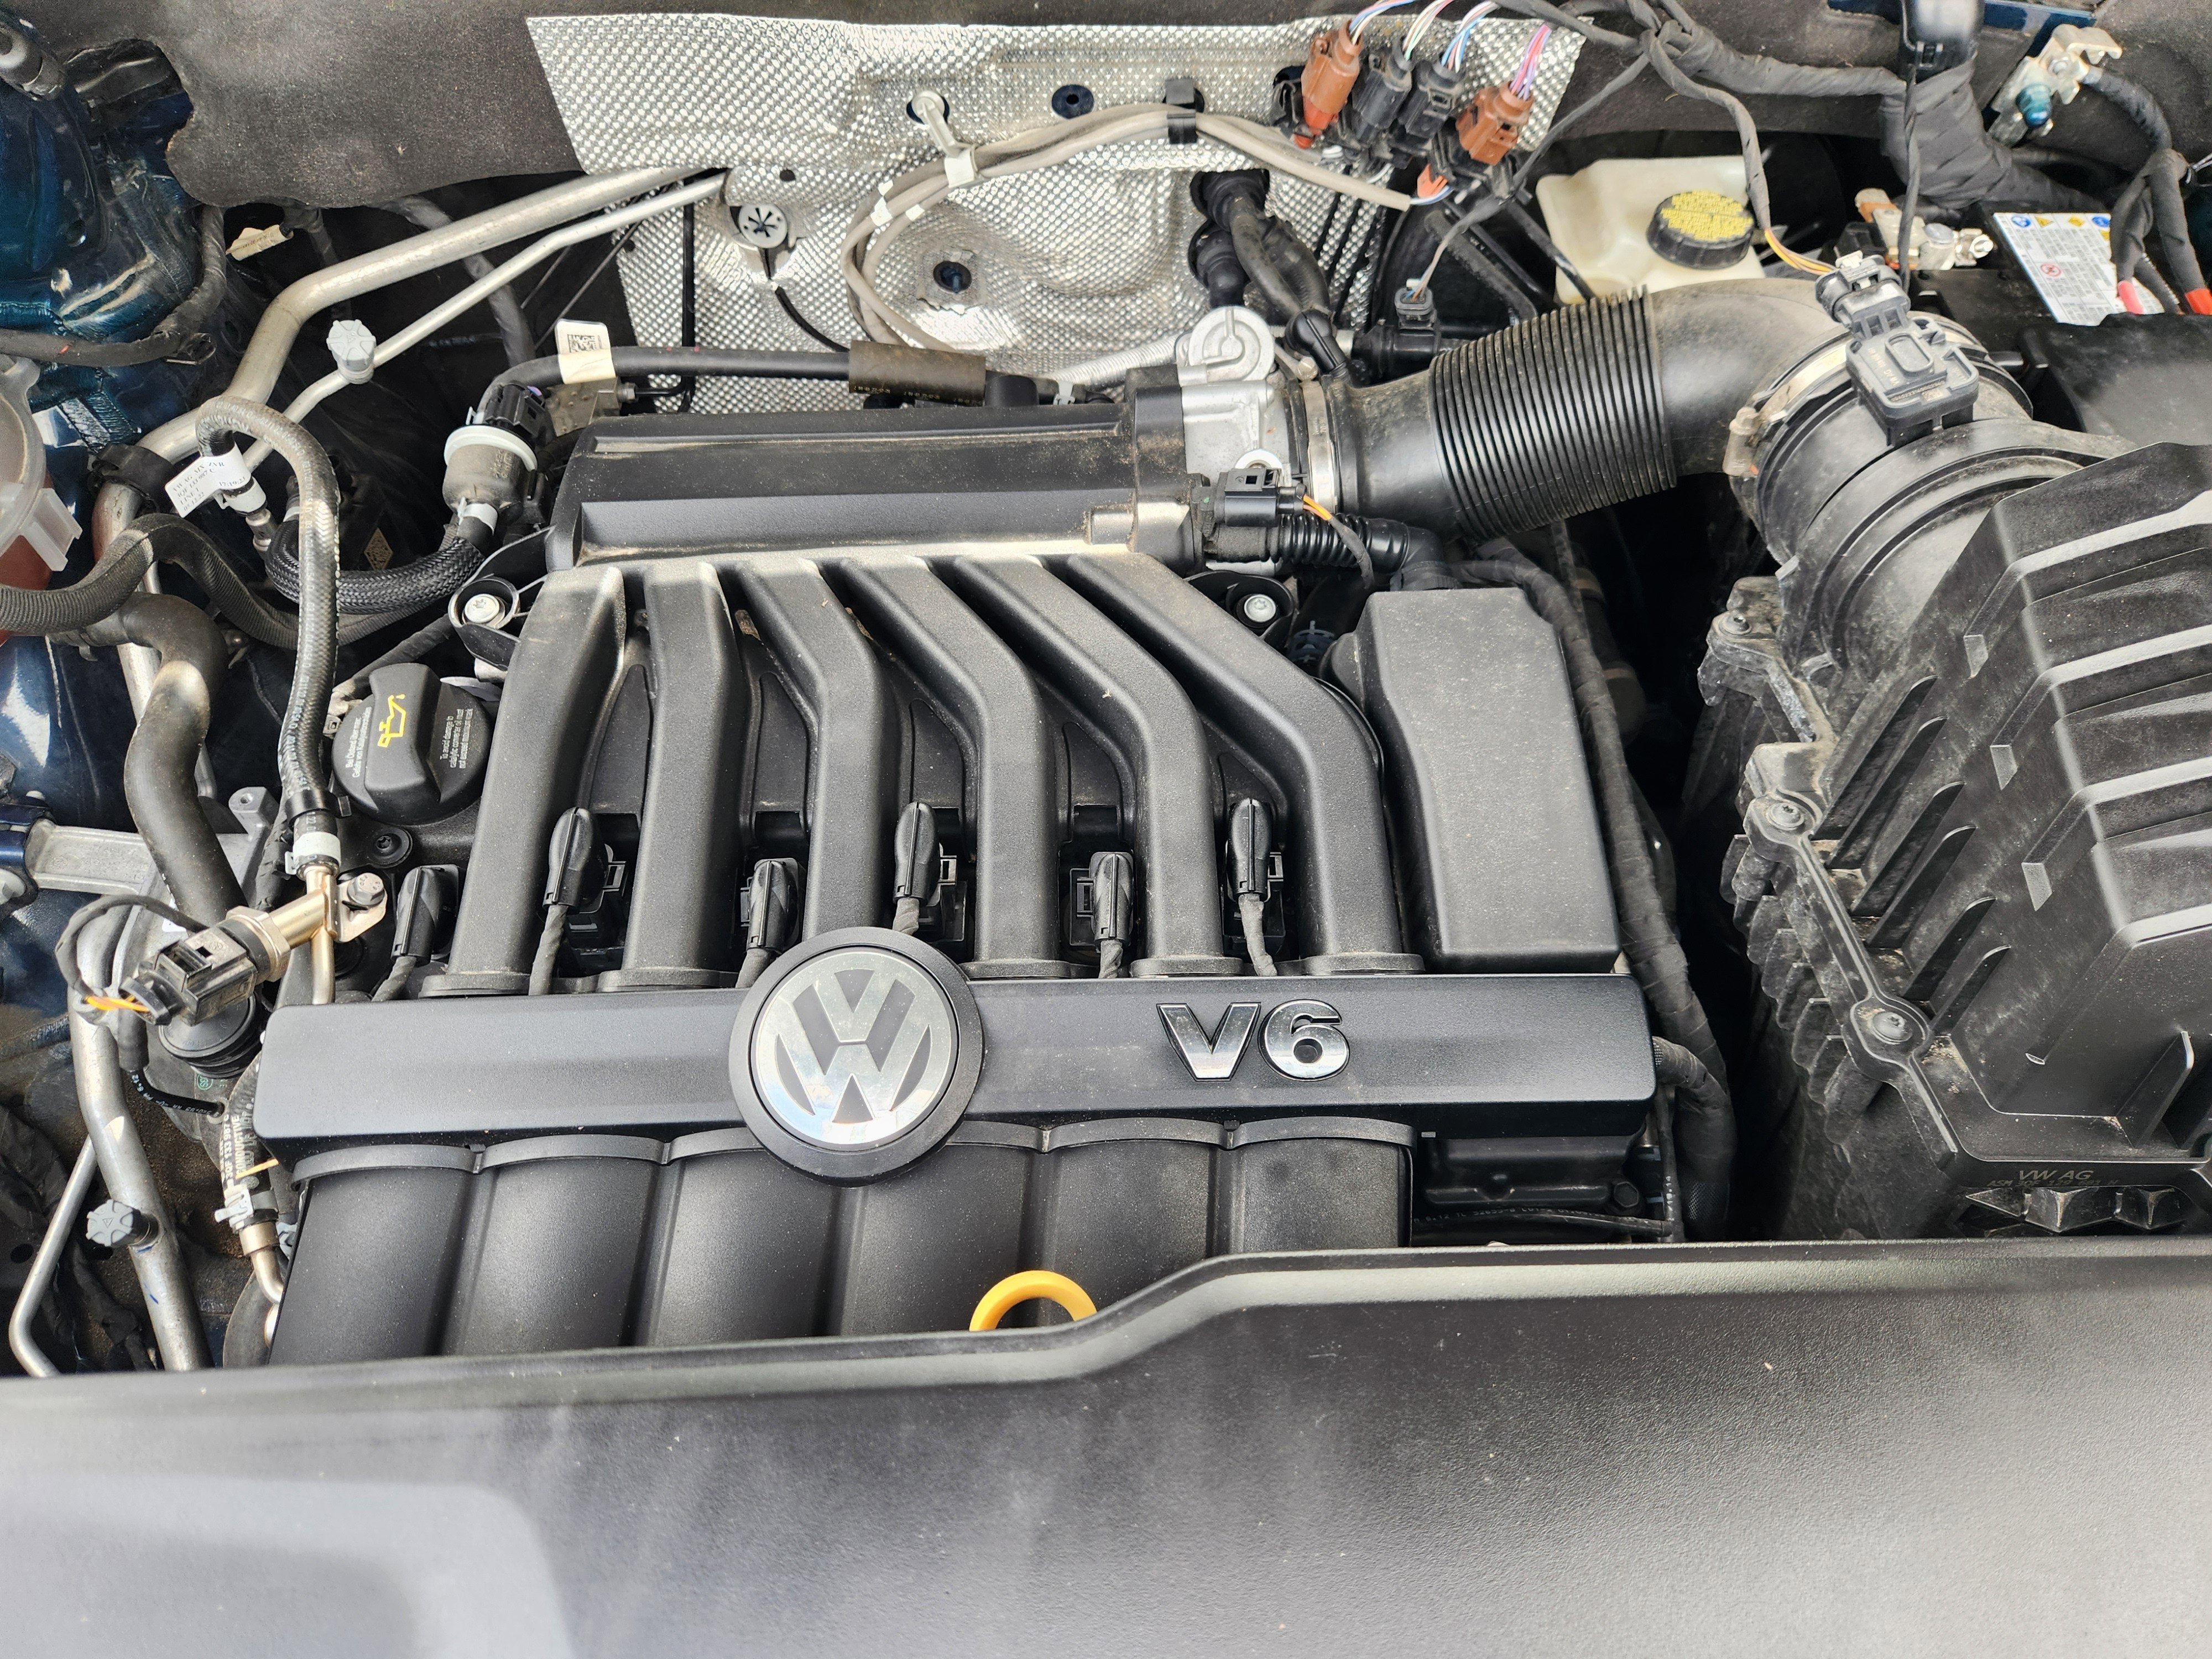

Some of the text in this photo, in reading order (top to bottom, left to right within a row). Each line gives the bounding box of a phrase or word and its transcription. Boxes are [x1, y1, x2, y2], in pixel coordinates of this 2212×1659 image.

[443, 721, 454, 739] damage
[452, 726, 461, 748] converter
[441, 739, 450, 753] avoid
[449, 748, 459, 768] catalytic
[762, 958, 946, 1136] VW
[1156, 999, 1350, 1082] V6
[224, 1141, 232, 1159] 133
[231, 1115, 246, 1175] CONDUCTIVE
[224, 1160, 233, 1180] 3QF
[2019, 1170, 2094, 1180] VW AG
